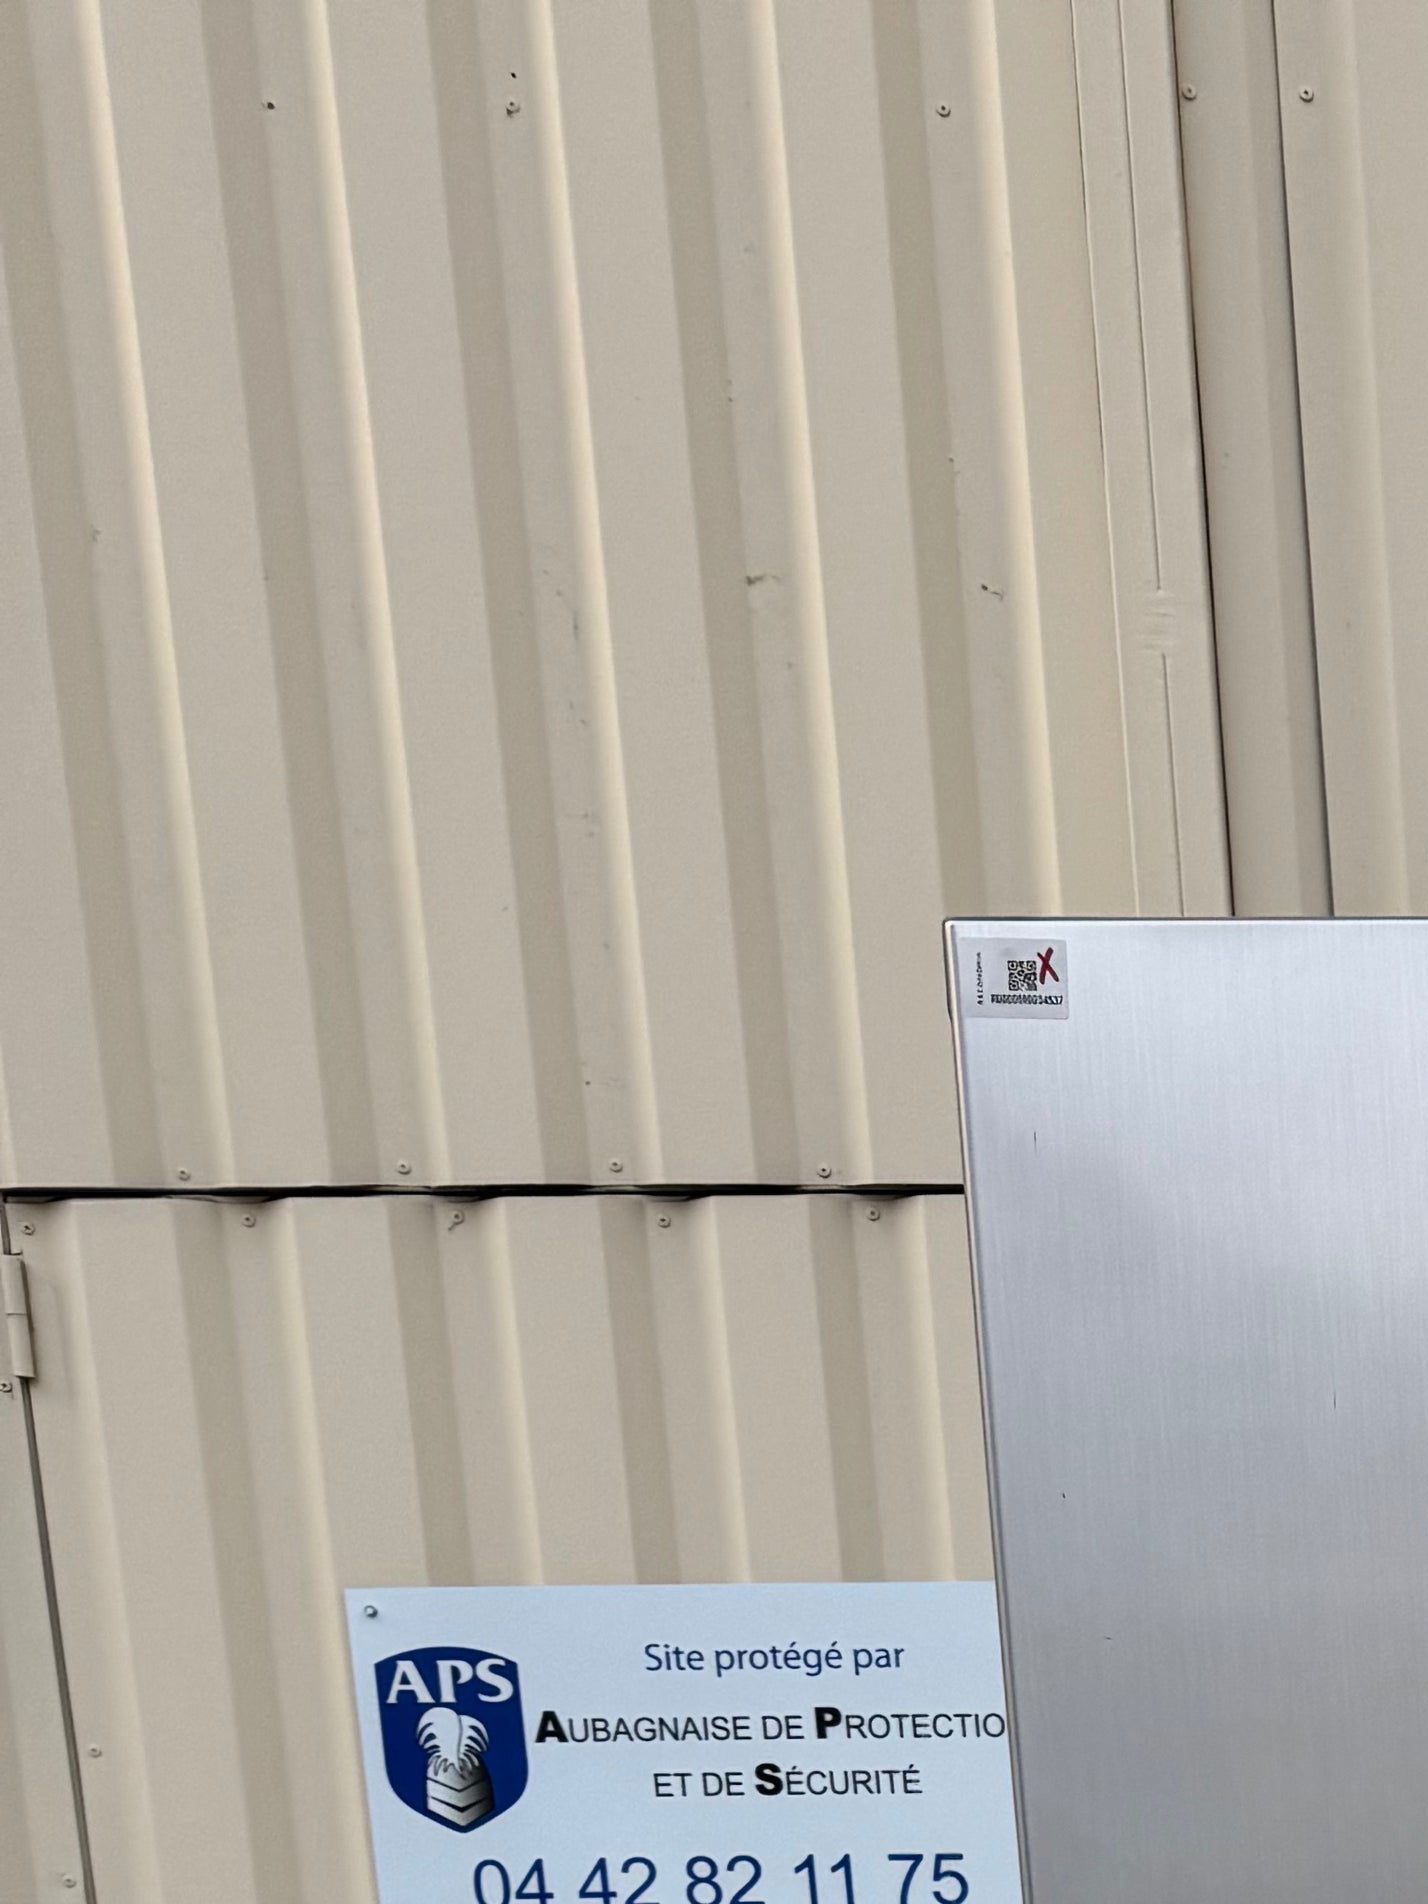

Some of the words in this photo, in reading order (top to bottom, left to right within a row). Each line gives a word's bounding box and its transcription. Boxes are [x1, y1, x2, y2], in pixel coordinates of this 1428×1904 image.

[645, 1643, 705, 1671] Site
[715, 1641, 843, 1677] protégé
[853, 1645, 905, 1675] par
[386, 1658, 514, 1704] APS
[535, 1710, 752, 1743] AUBAGNAISE
[762, 1715, 805, 1740] DE
[653, 1773, 692, 1797] ET
[702, 1772, 745, 1796] DE
[754, 1763, 923, 1796] SÉCURITÉ
